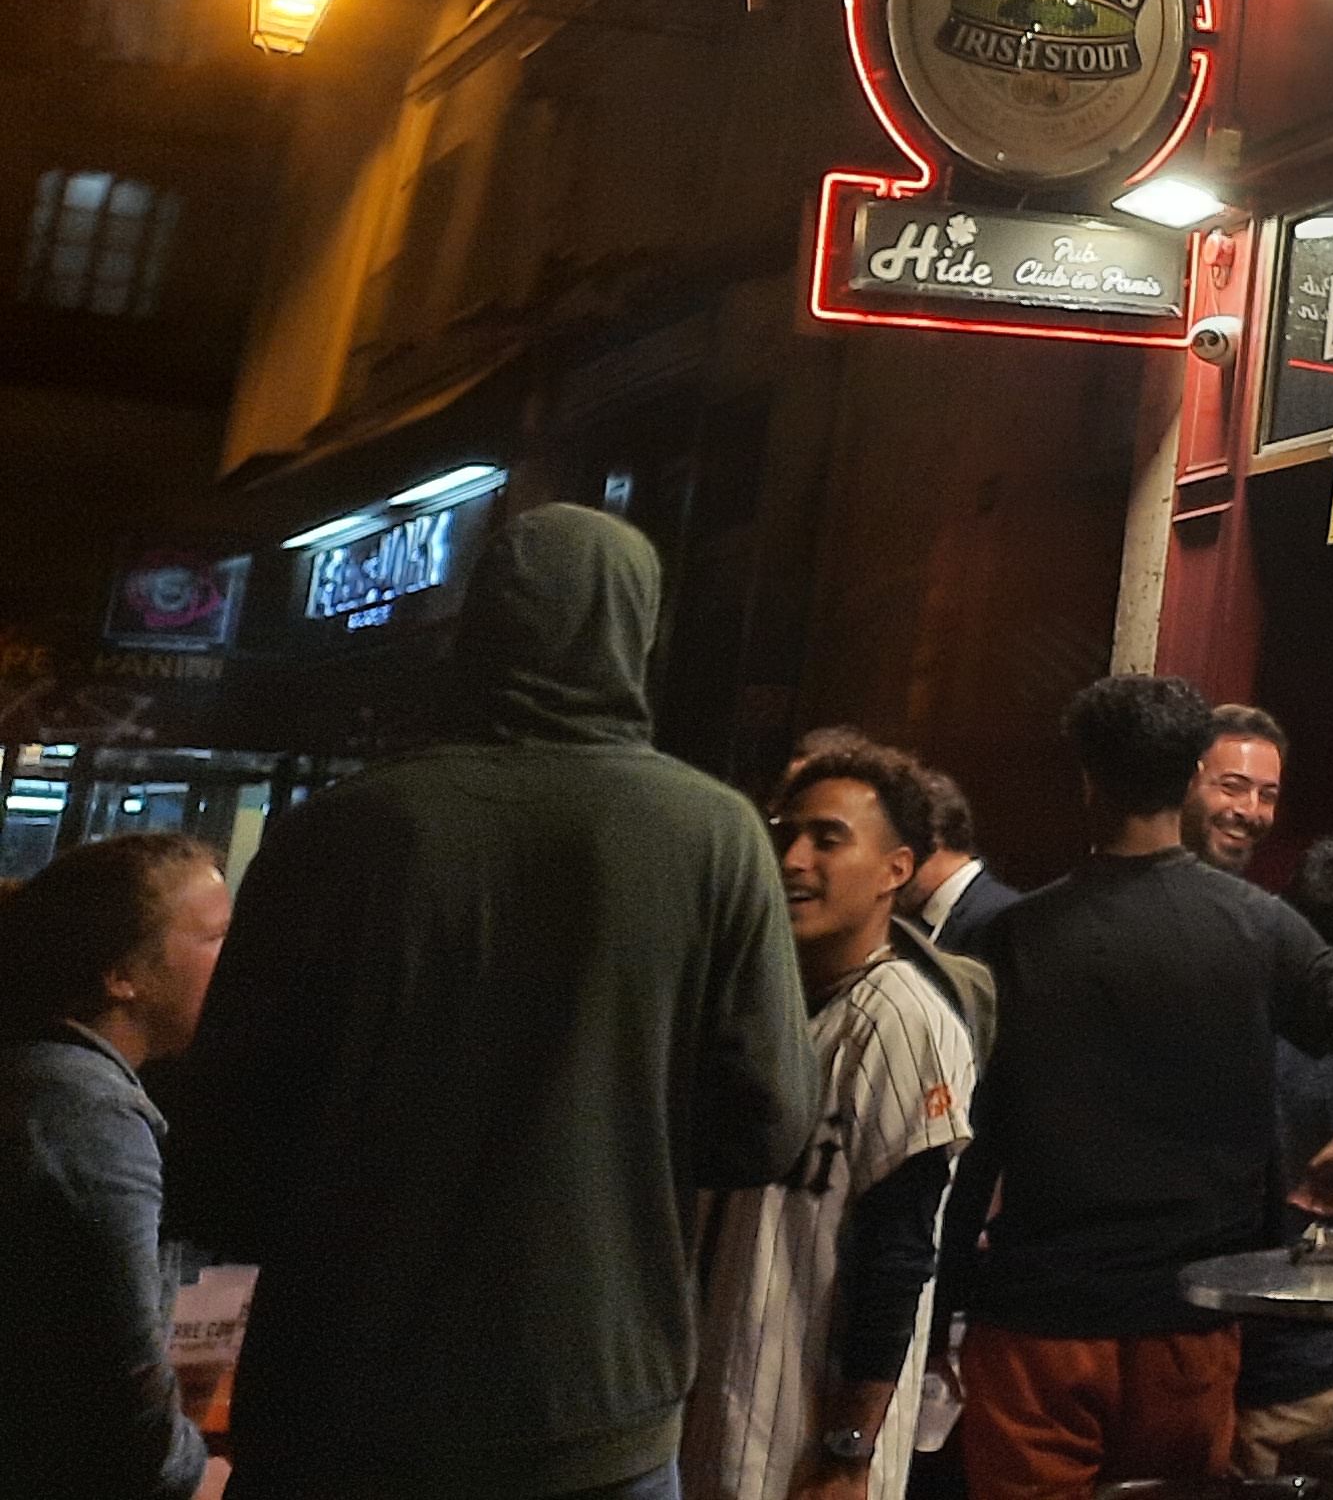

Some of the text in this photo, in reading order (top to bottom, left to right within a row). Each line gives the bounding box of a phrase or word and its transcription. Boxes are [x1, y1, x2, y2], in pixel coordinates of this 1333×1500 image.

[954, 24, 1130, 73] IRISH STOUT
[869, 221, 993, 287] Hide
[1053, 237, 1100, 265] Pub
[1015, 261, 1162, 297] Club in Paris
